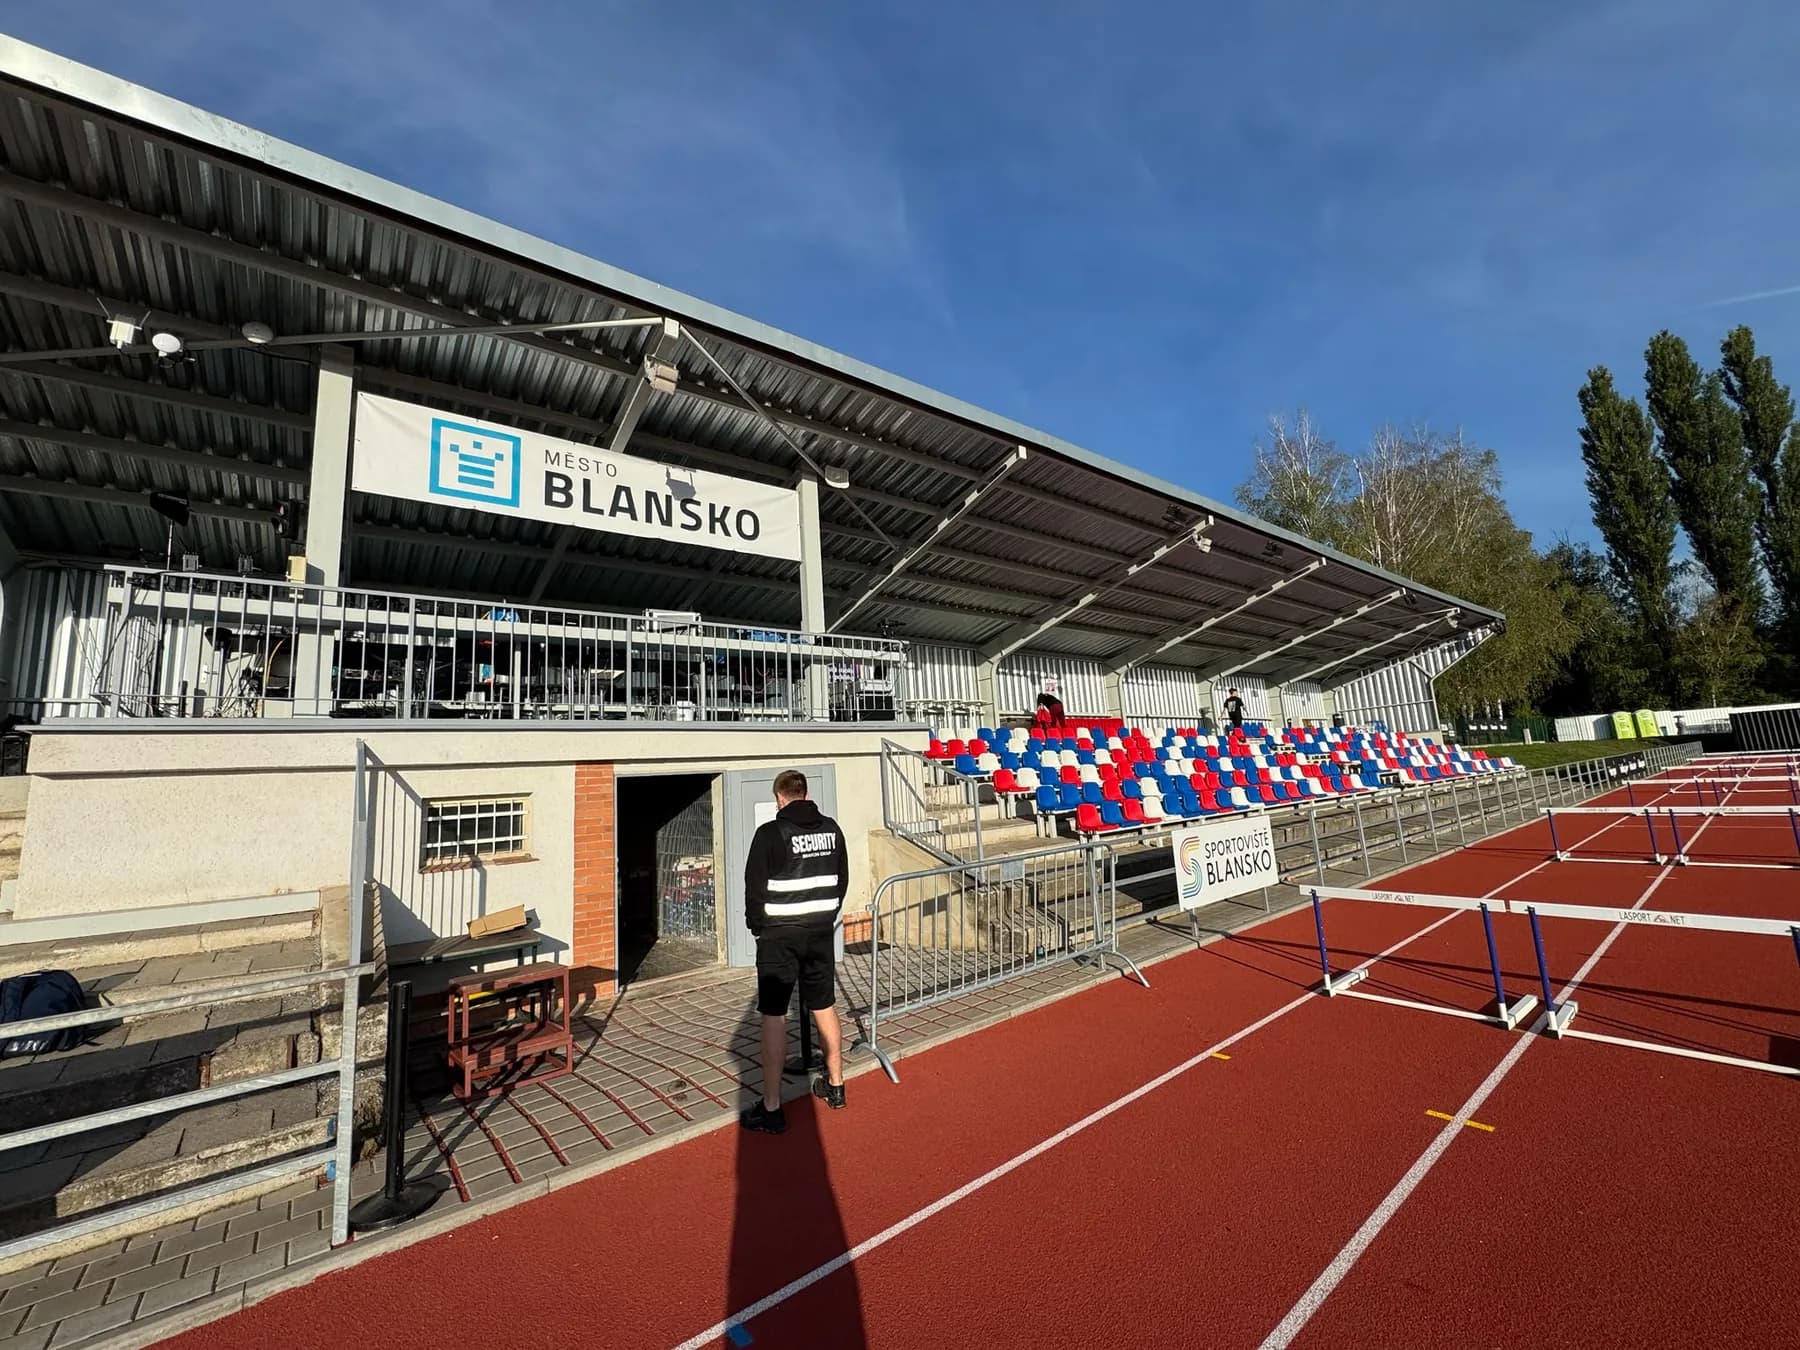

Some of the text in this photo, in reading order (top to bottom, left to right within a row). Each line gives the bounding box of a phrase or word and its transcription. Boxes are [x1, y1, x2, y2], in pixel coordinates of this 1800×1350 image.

[545, 449, 617, 478] MĚSTO
[544, 470, 760, 541] BLANSKO
[791, 832, 836, 854] SECURITY
[1204, 827, 1269, 859] SPORTOVIŠTĚ
[1206, 849, 1272, 886] BLANSKO
[1618, 911, 1685, 925] LASPORT NET
